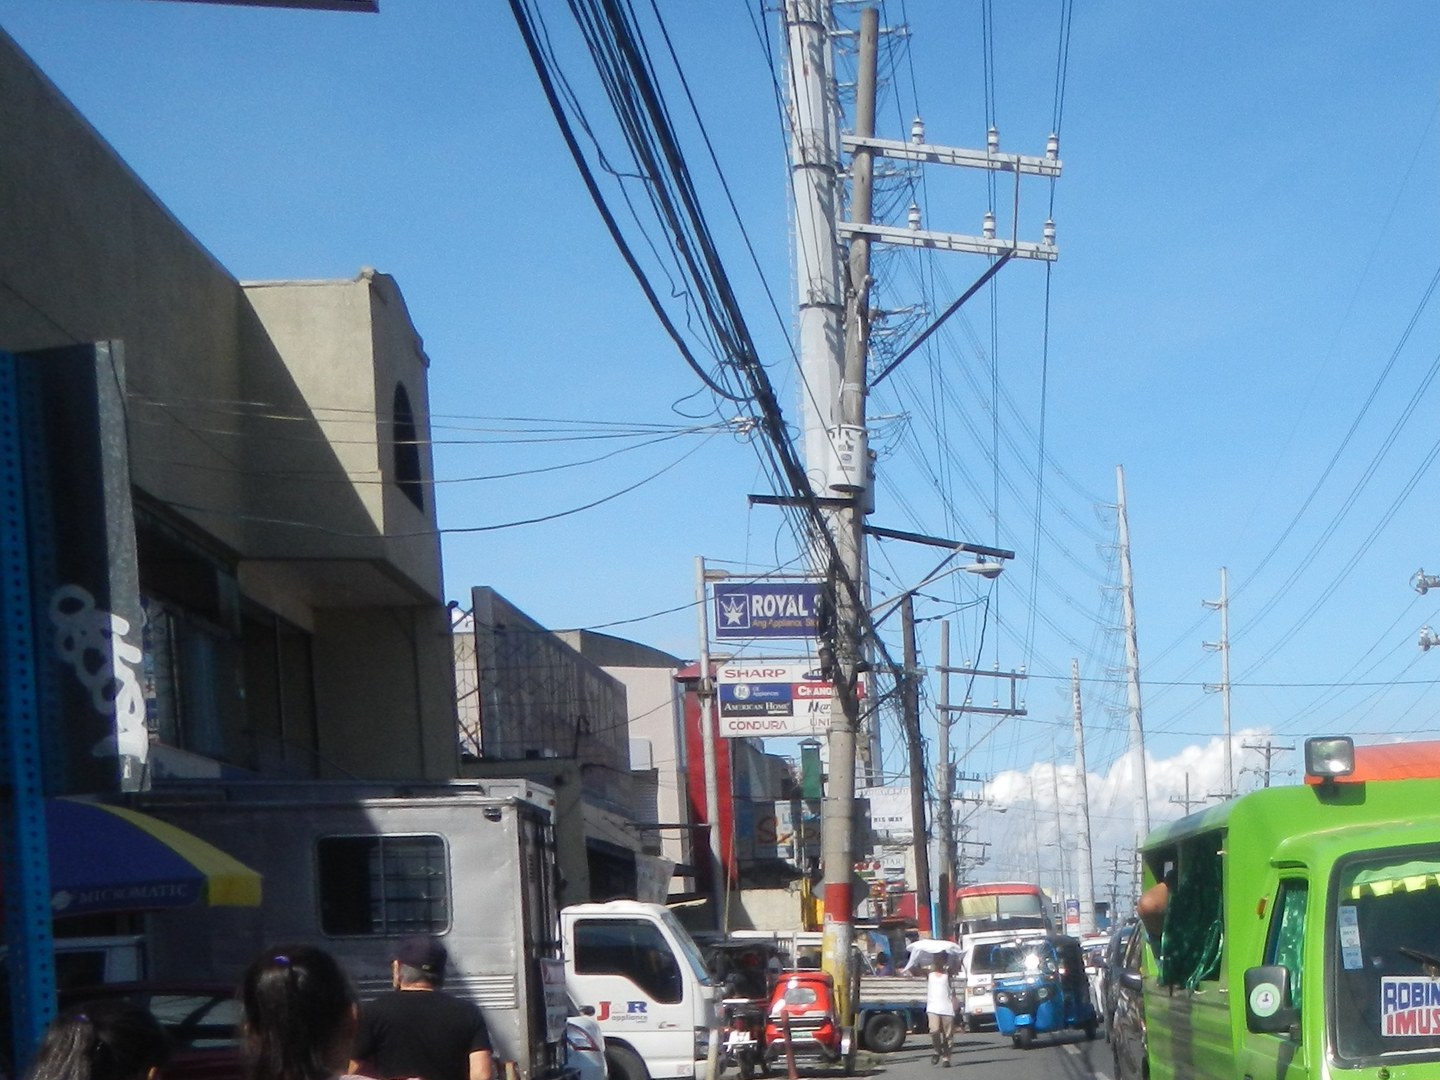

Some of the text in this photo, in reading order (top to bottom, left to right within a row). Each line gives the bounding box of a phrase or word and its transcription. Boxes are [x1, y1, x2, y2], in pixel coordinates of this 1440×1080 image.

[752, 594, 809, 617] ROYAL
[724, 668, 787, 678] SHARP
[724, 702, 789, 711] AMERICAN HOME
[728, 720, 788, 731] CONDURA
[611, 1014, 648, 1022] appliance
